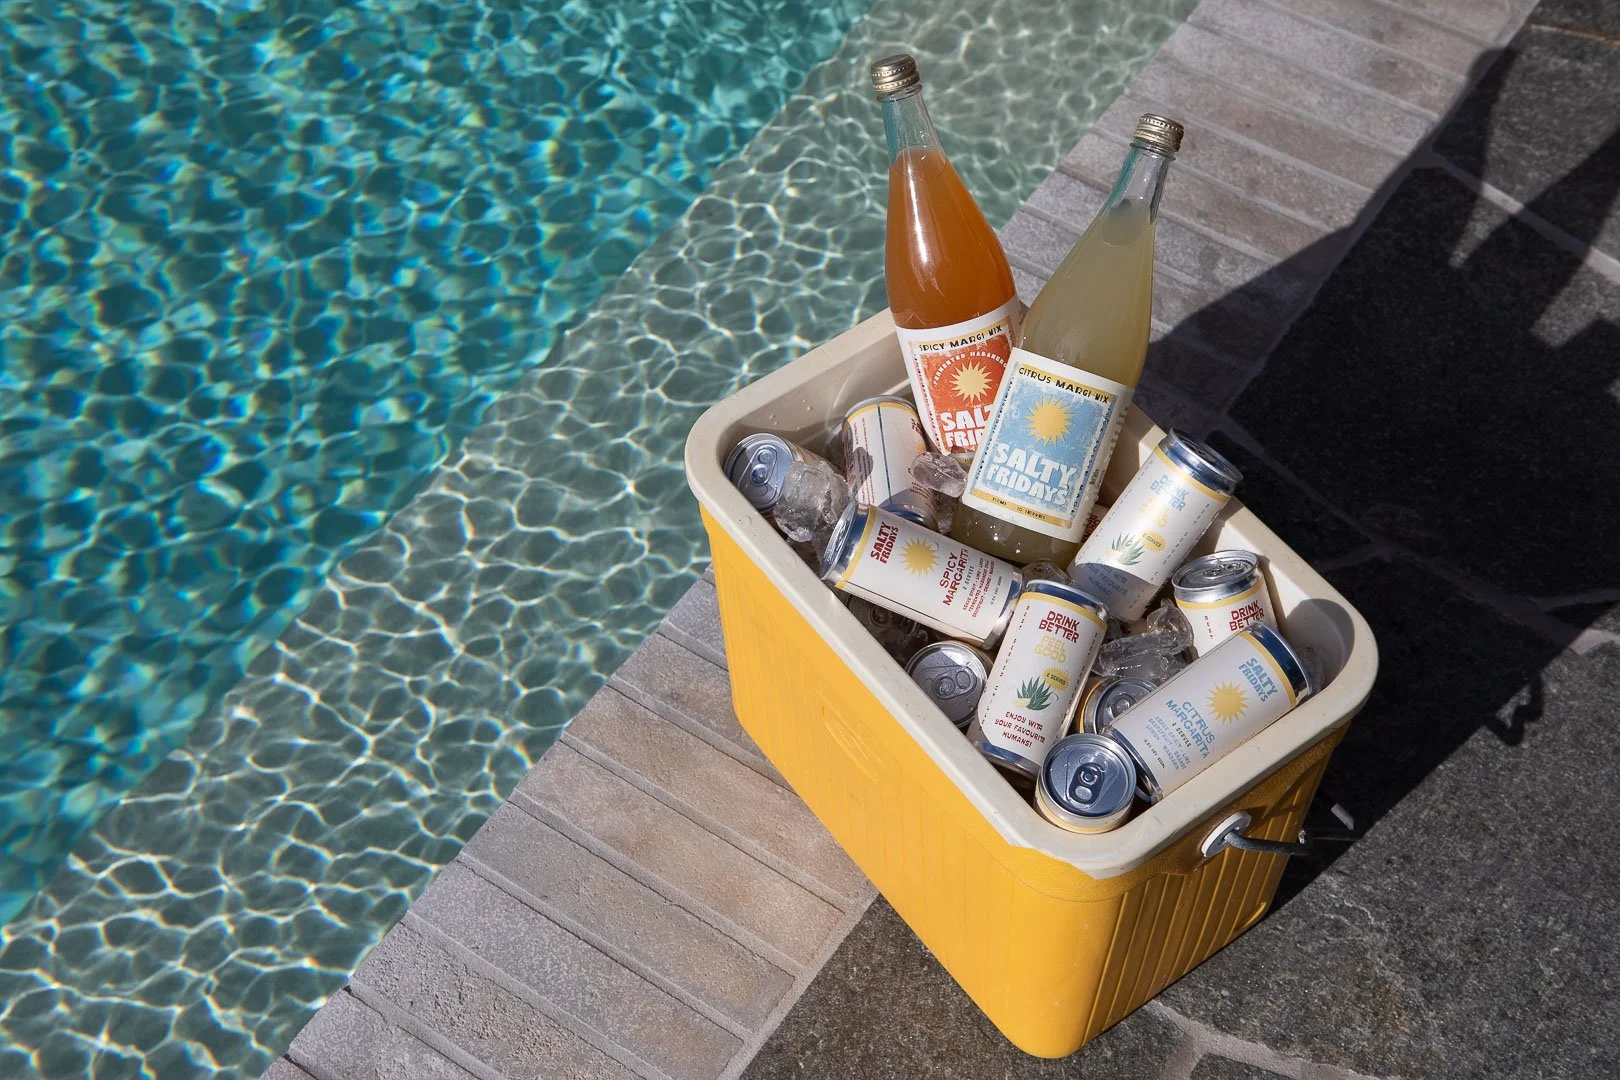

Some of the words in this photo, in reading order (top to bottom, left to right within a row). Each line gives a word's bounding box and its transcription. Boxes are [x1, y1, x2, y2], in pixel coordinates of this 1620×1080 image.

[919, 342, 945, 352] SPICY
[949, 333, 985, 349] MARGI
[988, 324, 1002, 337] MIX
[933, 353, 966, 386] FERMENTED
[1018, 366, 1052, 384] CITRUS
[1055, 379, 1092, 398] MARGI
[1095, 392, 1110, 405] MIX
[993, 443, 1077, 490] SALTY
[986, 463, 1068, 506] FRIDAYS
[870, 521, 891, 561] SALTY
[880, 526, 899, 564] FRIDAYS
[939, 552, 959, 589] SPICY
[942, 548, 969, 606] MARGARITA
[965, 565, 975, 586] SERVES
[1046, 610, 1081, 629] DRINK
[1230, 599, 1260, 620] DRINK
[1038, 619, 1080, 644] BETTER
[1041, 635, 1065, 650] FEEL
[1034, 643, 1067, 664] GOOD
[1050, 674, 1067, 686] SERVES
[1238, 663, 1270, 703] FRIDAYS
[1246, 657, 1278, 696] SALTY
[994, 718, 1012, 730] YOUR
[1013, 723, 1046, 744] FAVOURITE
[1005, 711, 1026, 724] ENJOY
[1028, 719, 1043, 732] WITH
[1165, 699, 1209, 760] MARGARITA
[1182, 701, 1216, 744] CITRUS
[1002, 731, 1033, 748] HUMANS!
[1175, 727, 1191, 747] SERVES
